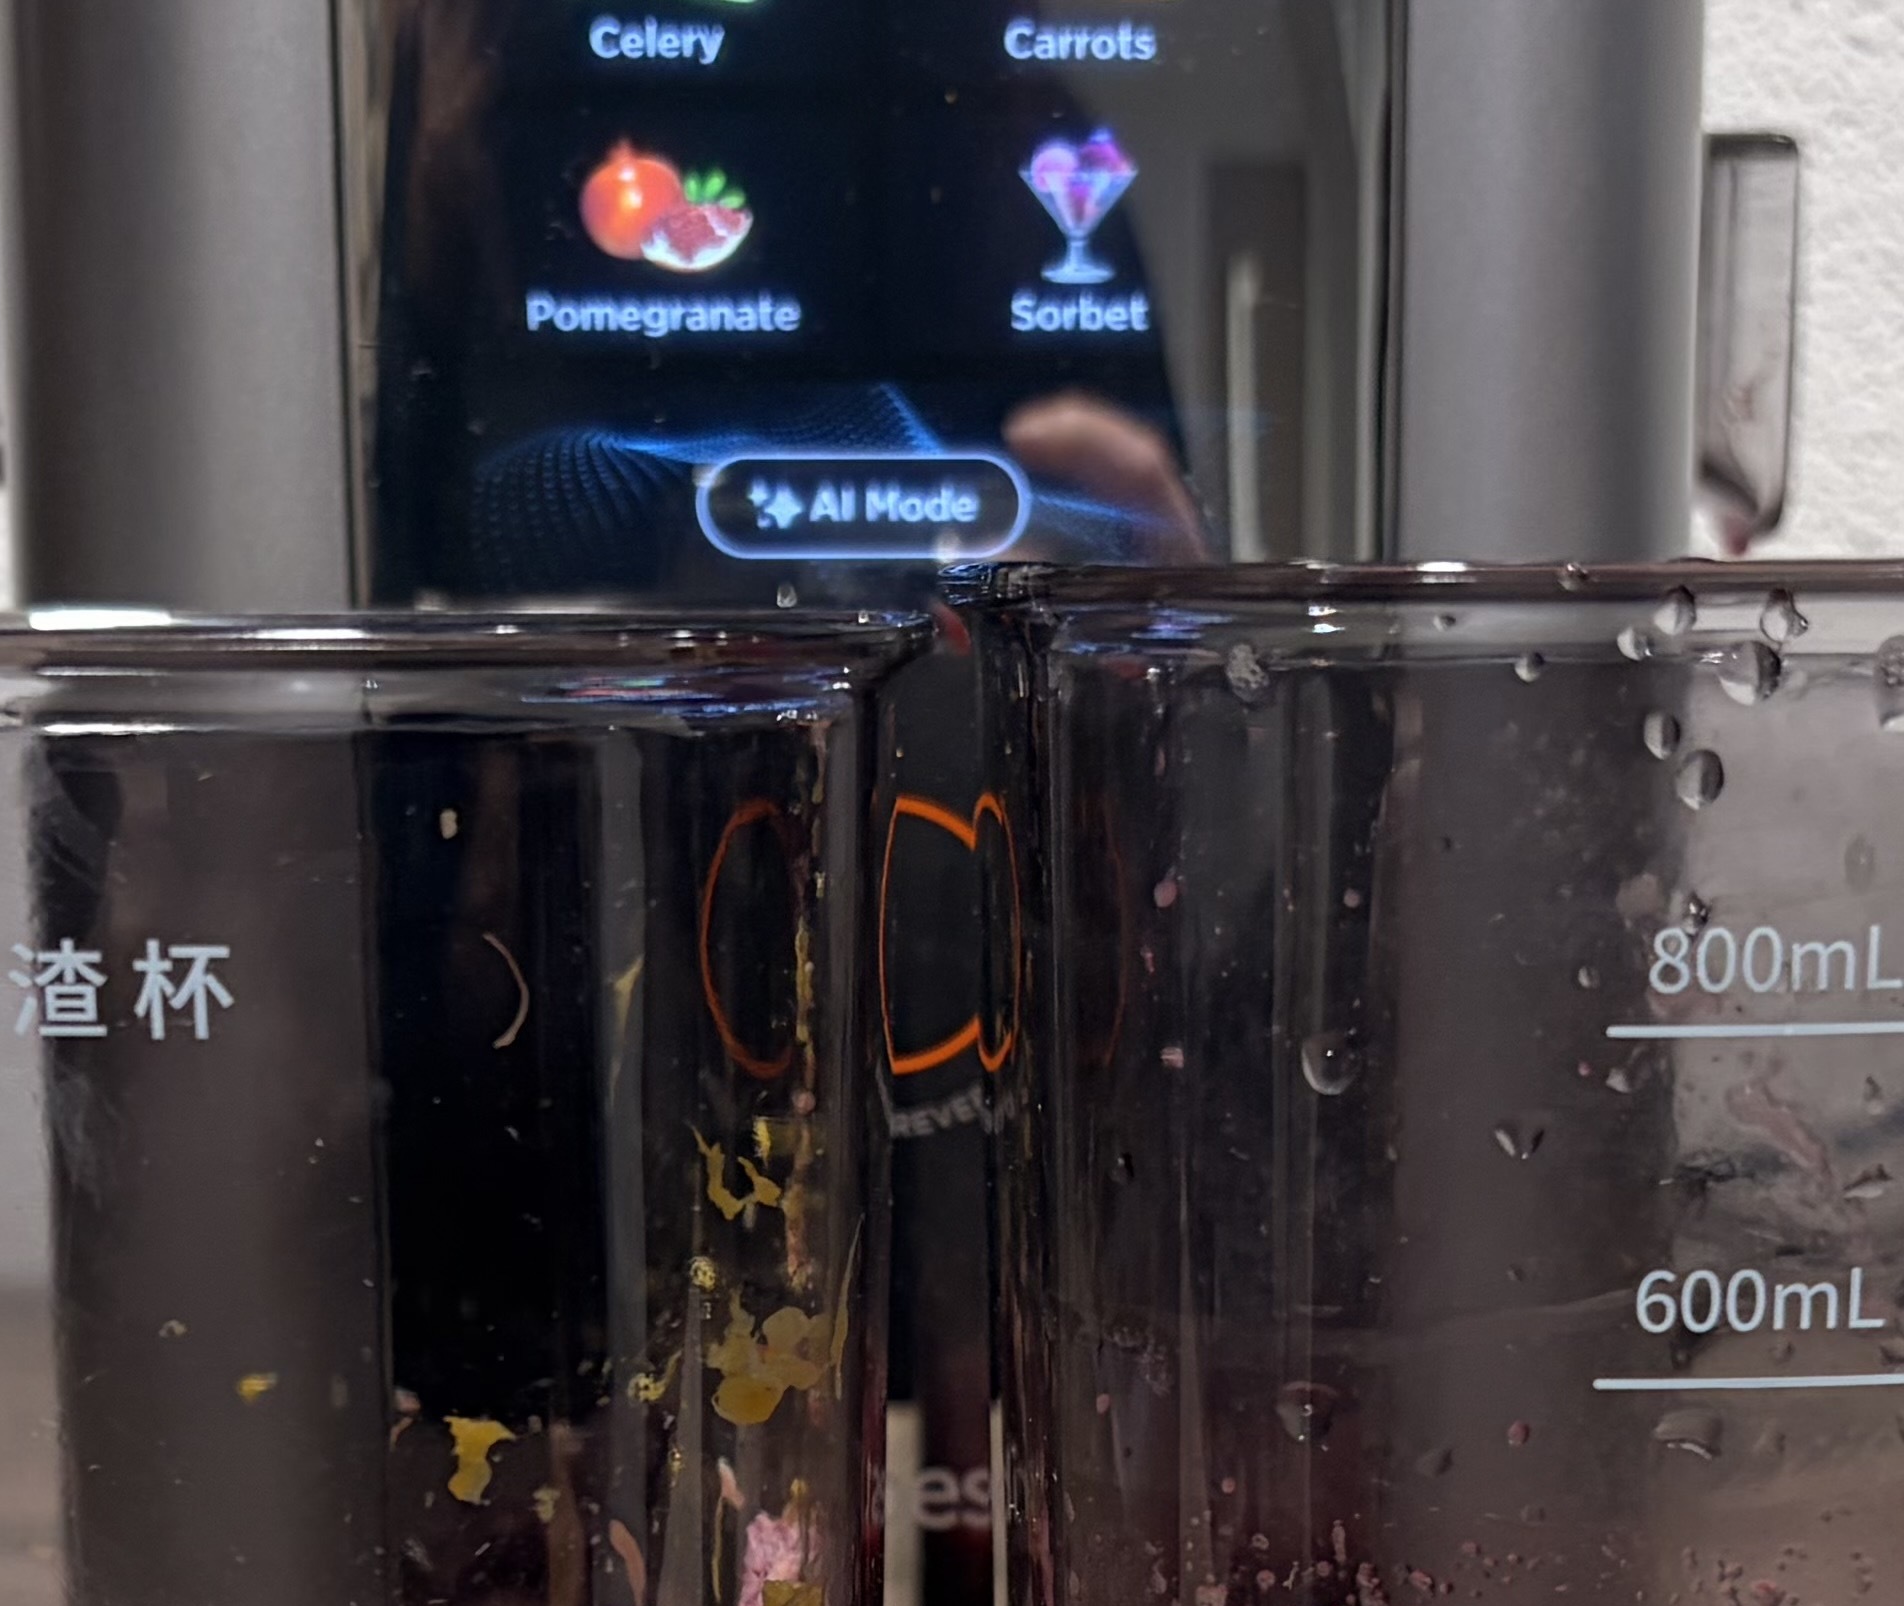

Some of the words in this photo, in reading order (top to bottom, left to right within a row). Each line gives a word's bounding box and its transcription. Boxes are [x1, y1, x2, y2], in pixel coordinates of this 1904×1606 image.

[588, 17, 726, 66] Celery
[1003, 18, 1158, 62] Carrots
[526, 293, 801, 338] Pomegranate
[1010, 291, 1149, 333] Sorbet
[808, 483, 858, 523] AI
[864, 483, 981, 523] Mode
[1647, 923, 1904, 995] 800mL
[1634, 1267, 1886, 1334] 600mL
